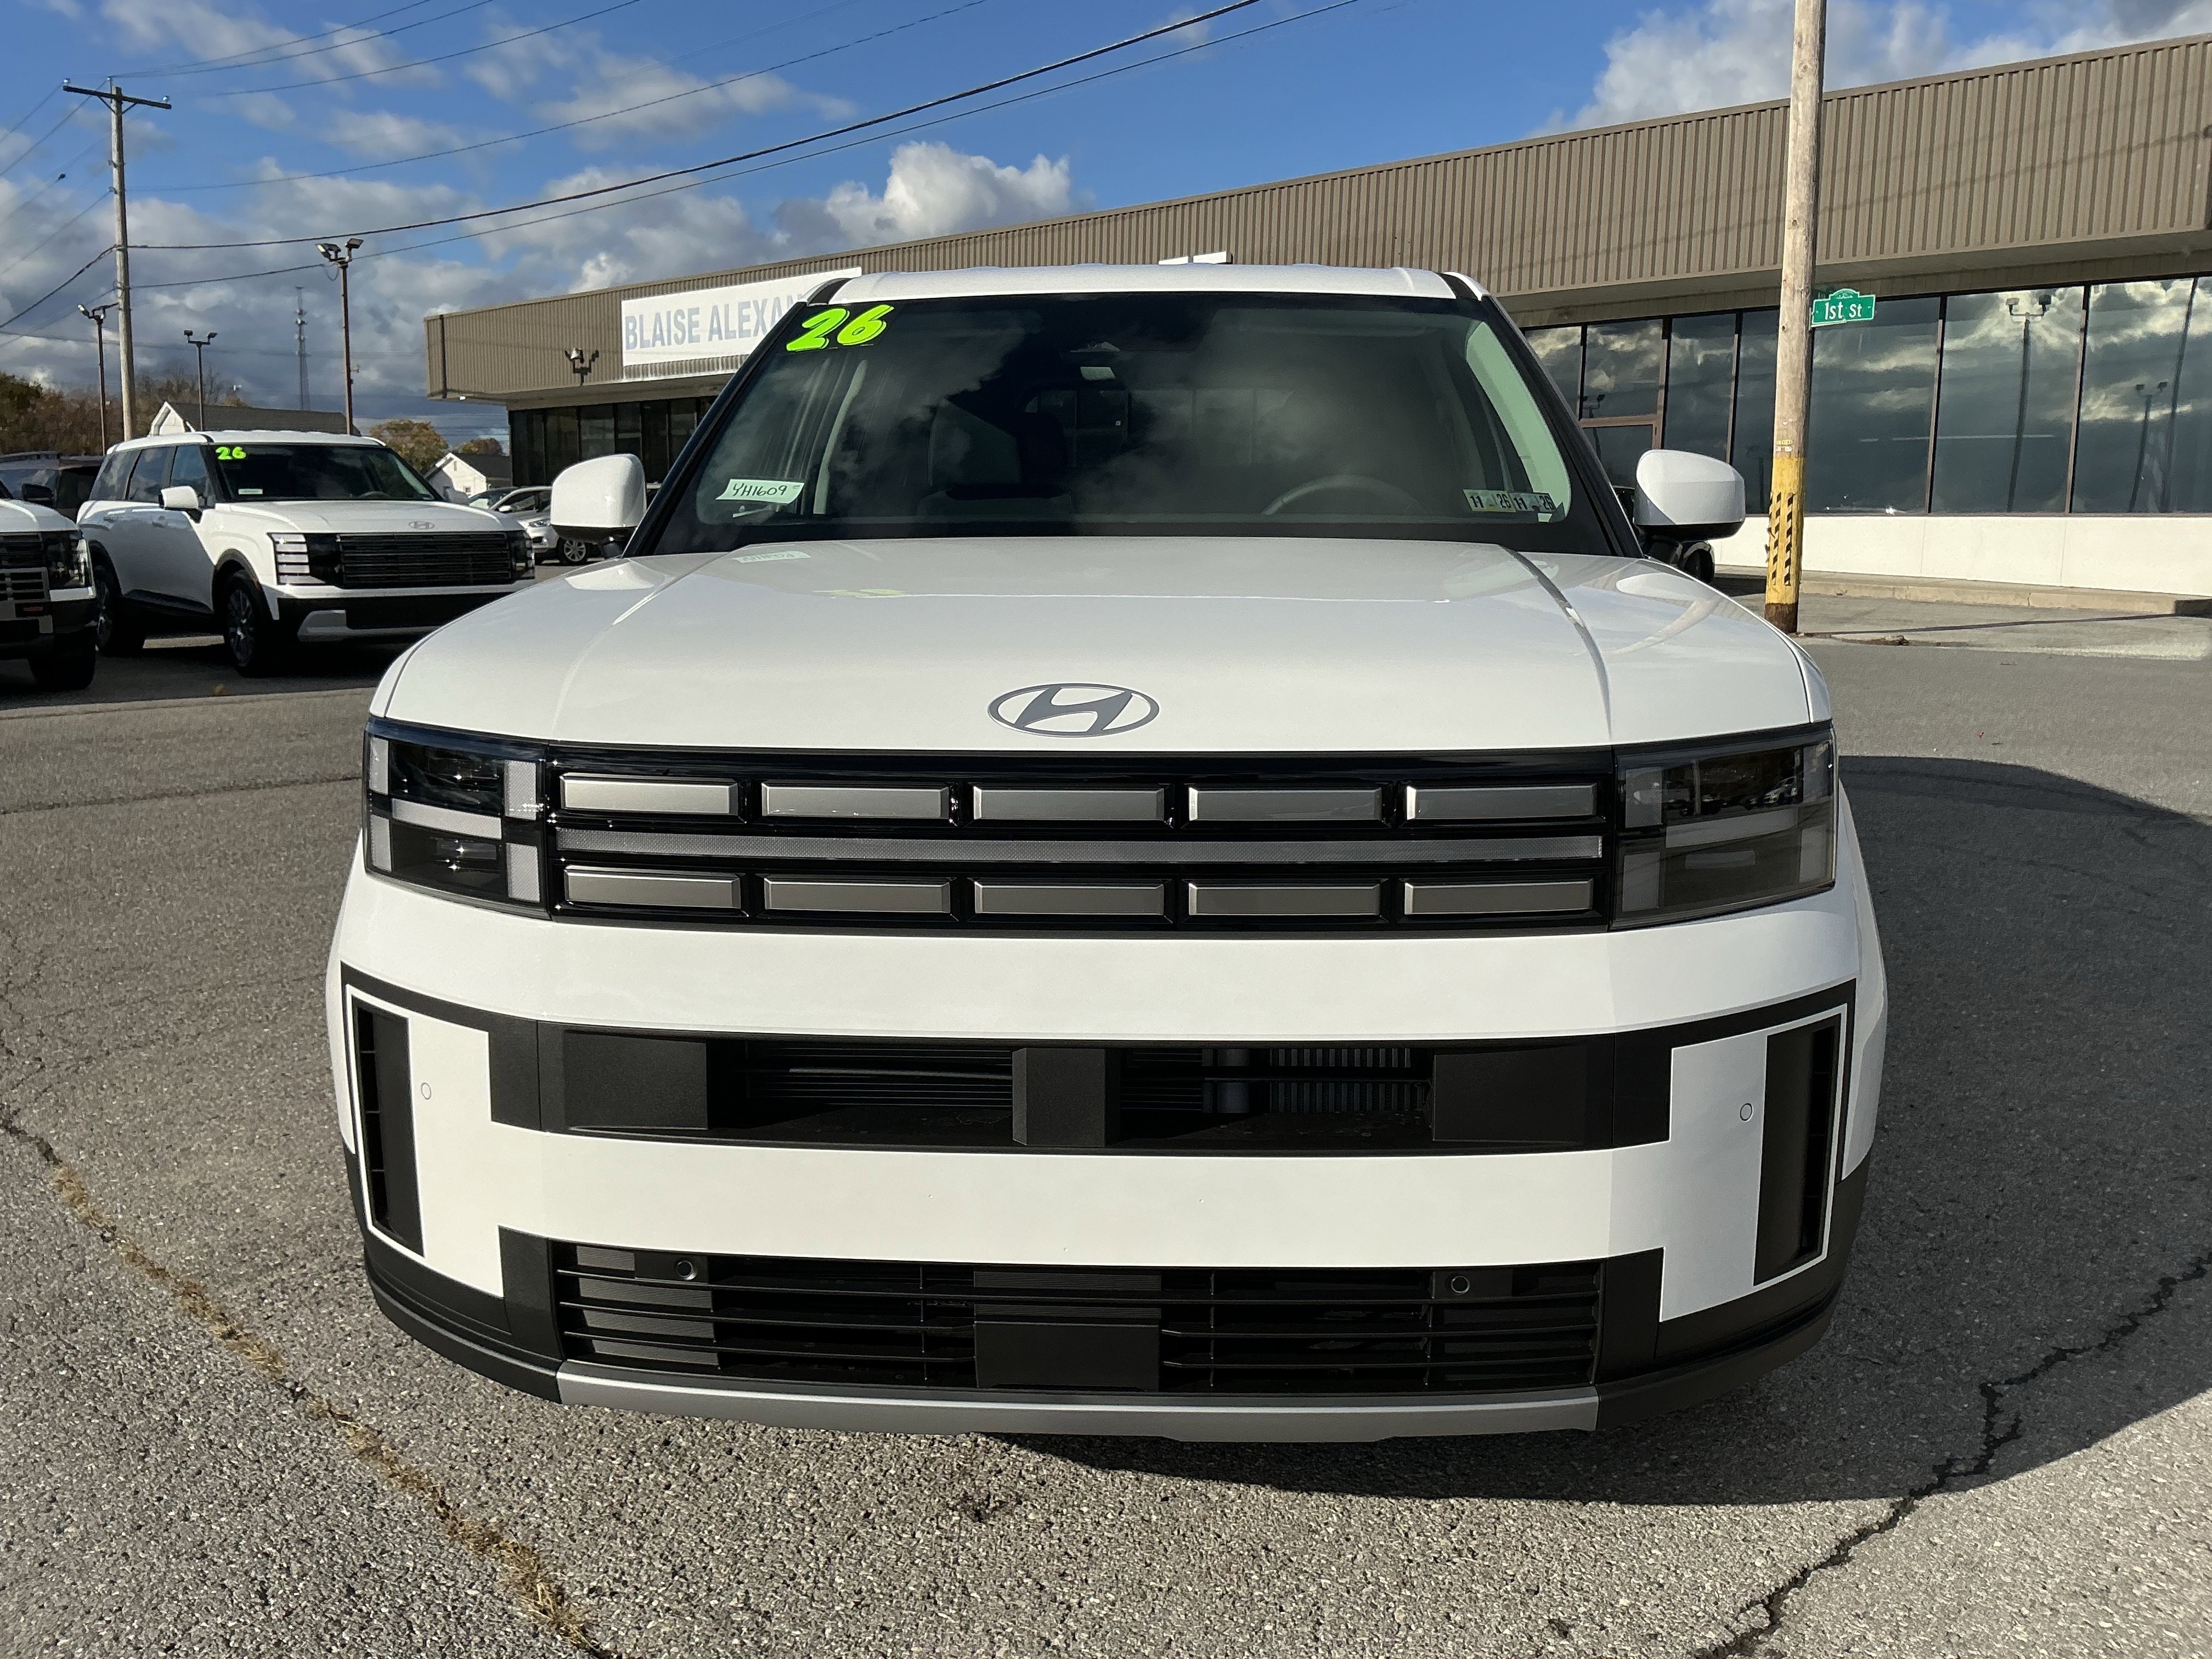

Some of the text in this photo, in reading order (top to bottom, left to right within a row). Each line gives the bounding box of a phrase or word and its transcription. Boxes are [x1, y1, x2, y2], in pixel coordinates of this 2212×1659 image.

[1825, 301, 1863, 320] 1st St
[624, 307, 701, 351] BLAISE
[786, 304, 895, 352] 26
[215, 446, 246, 460] 26
[1469, 495, 1485, 509] 11
